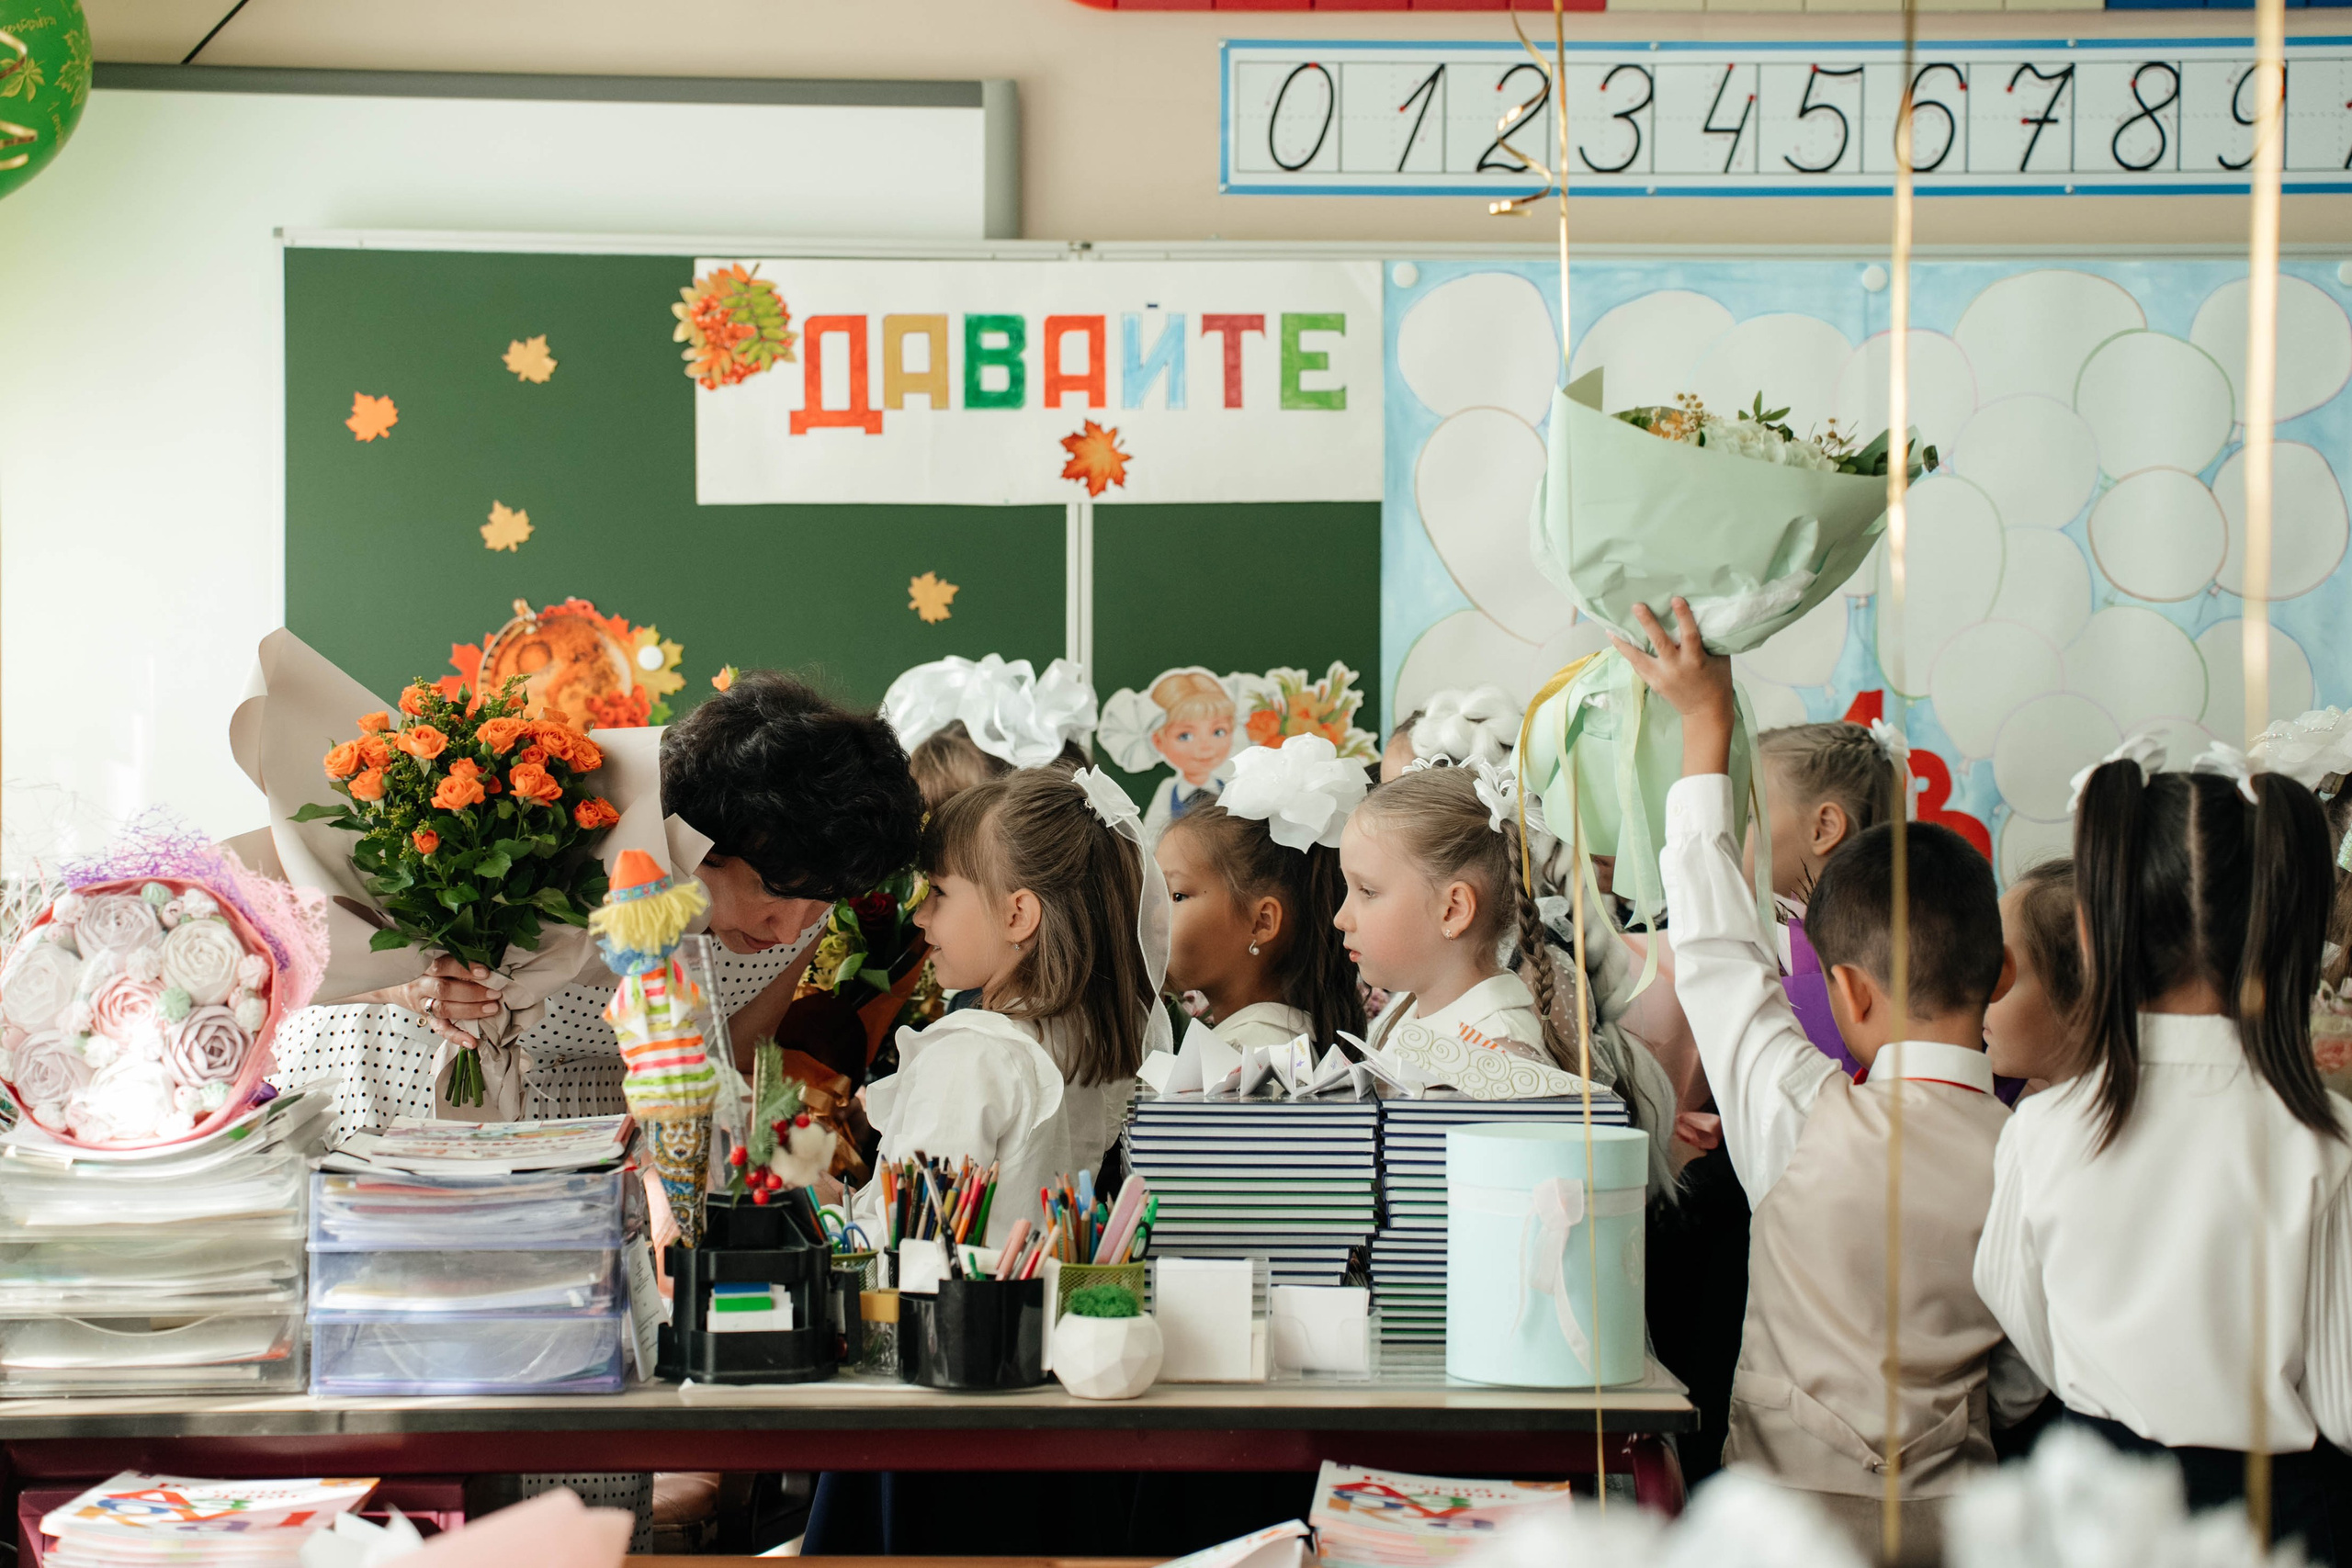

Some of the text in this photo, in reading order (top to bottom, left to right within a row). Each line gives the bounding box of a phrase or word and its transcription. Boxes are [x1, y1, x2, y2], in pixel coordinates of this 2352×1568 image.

[1268, 62, 1335, 172] 0
[1398, 63, 1446, 173] 1
[1476, 63, 1552, 173] 2
[1578, 64, 1655, 173] 3
[1703, 63, 1757, 174] 4
[1783, 63, 1864, 173] 5
[1895, 62, 1968, 173] 6
[2007, 62, 2075, 172] 7
[2111, 61, 2181, 171] 8
[2217, 62, 2287, 171] 9
[788, 301, 1348, 435] ДАВАЙТЕ
